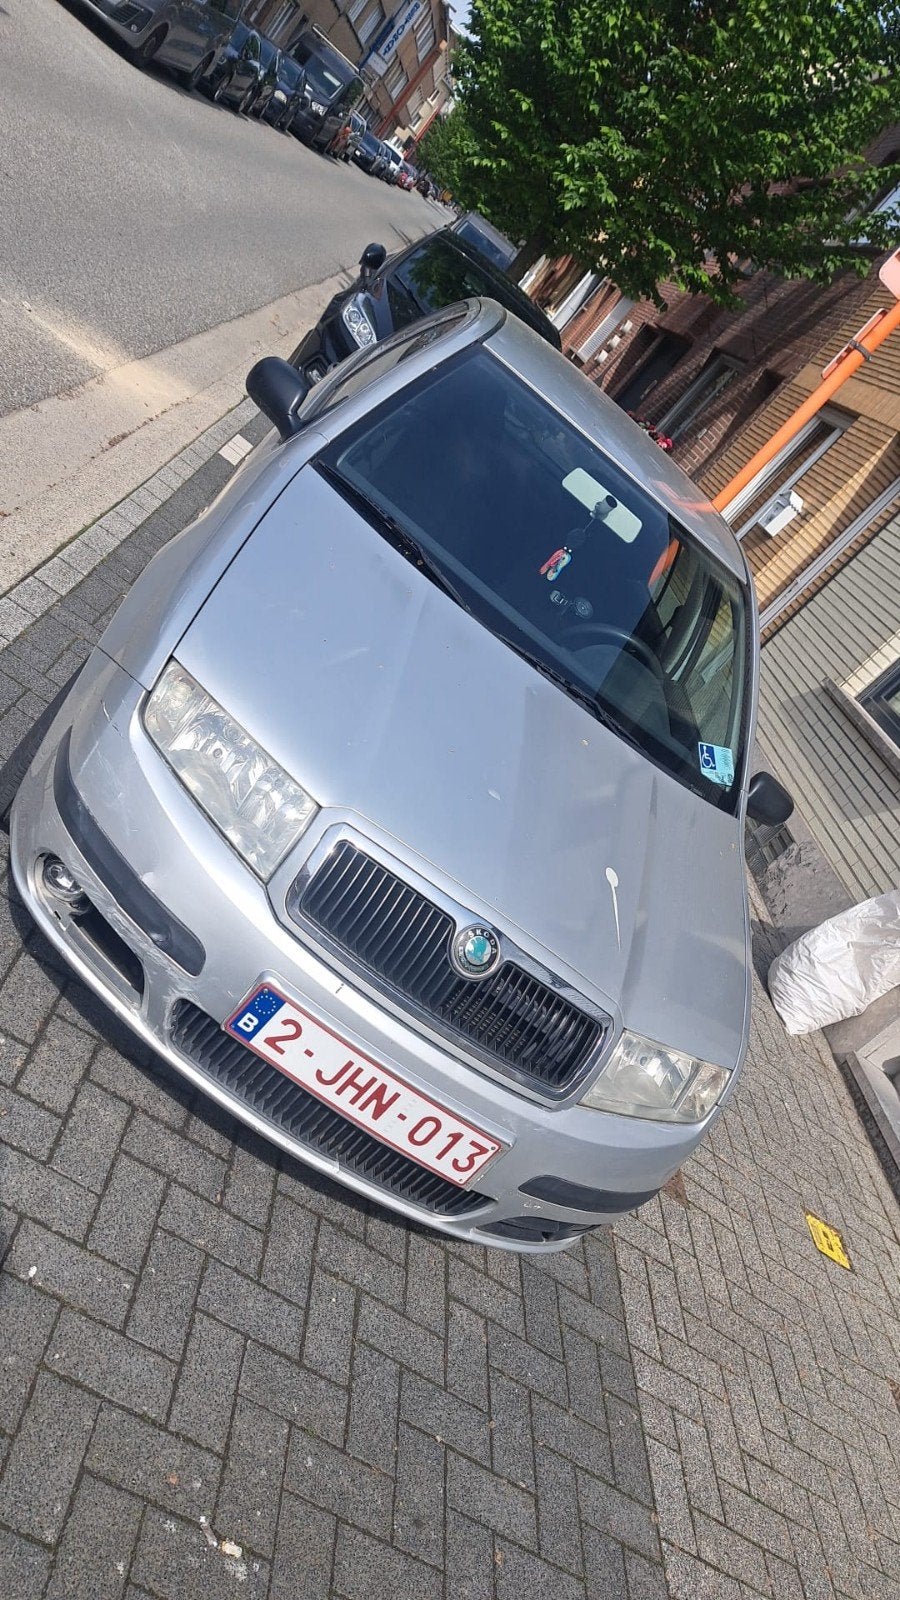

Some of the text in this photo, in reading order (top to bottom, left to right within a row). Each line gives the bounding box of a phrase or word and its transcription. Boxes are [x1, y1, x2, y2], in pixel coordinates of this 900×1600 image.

[383, 2, 420, 55] RESTAURANT
[237, 1012, 259, 1033] B
[263, 1018, 490, 1173] 2-JHN-013
